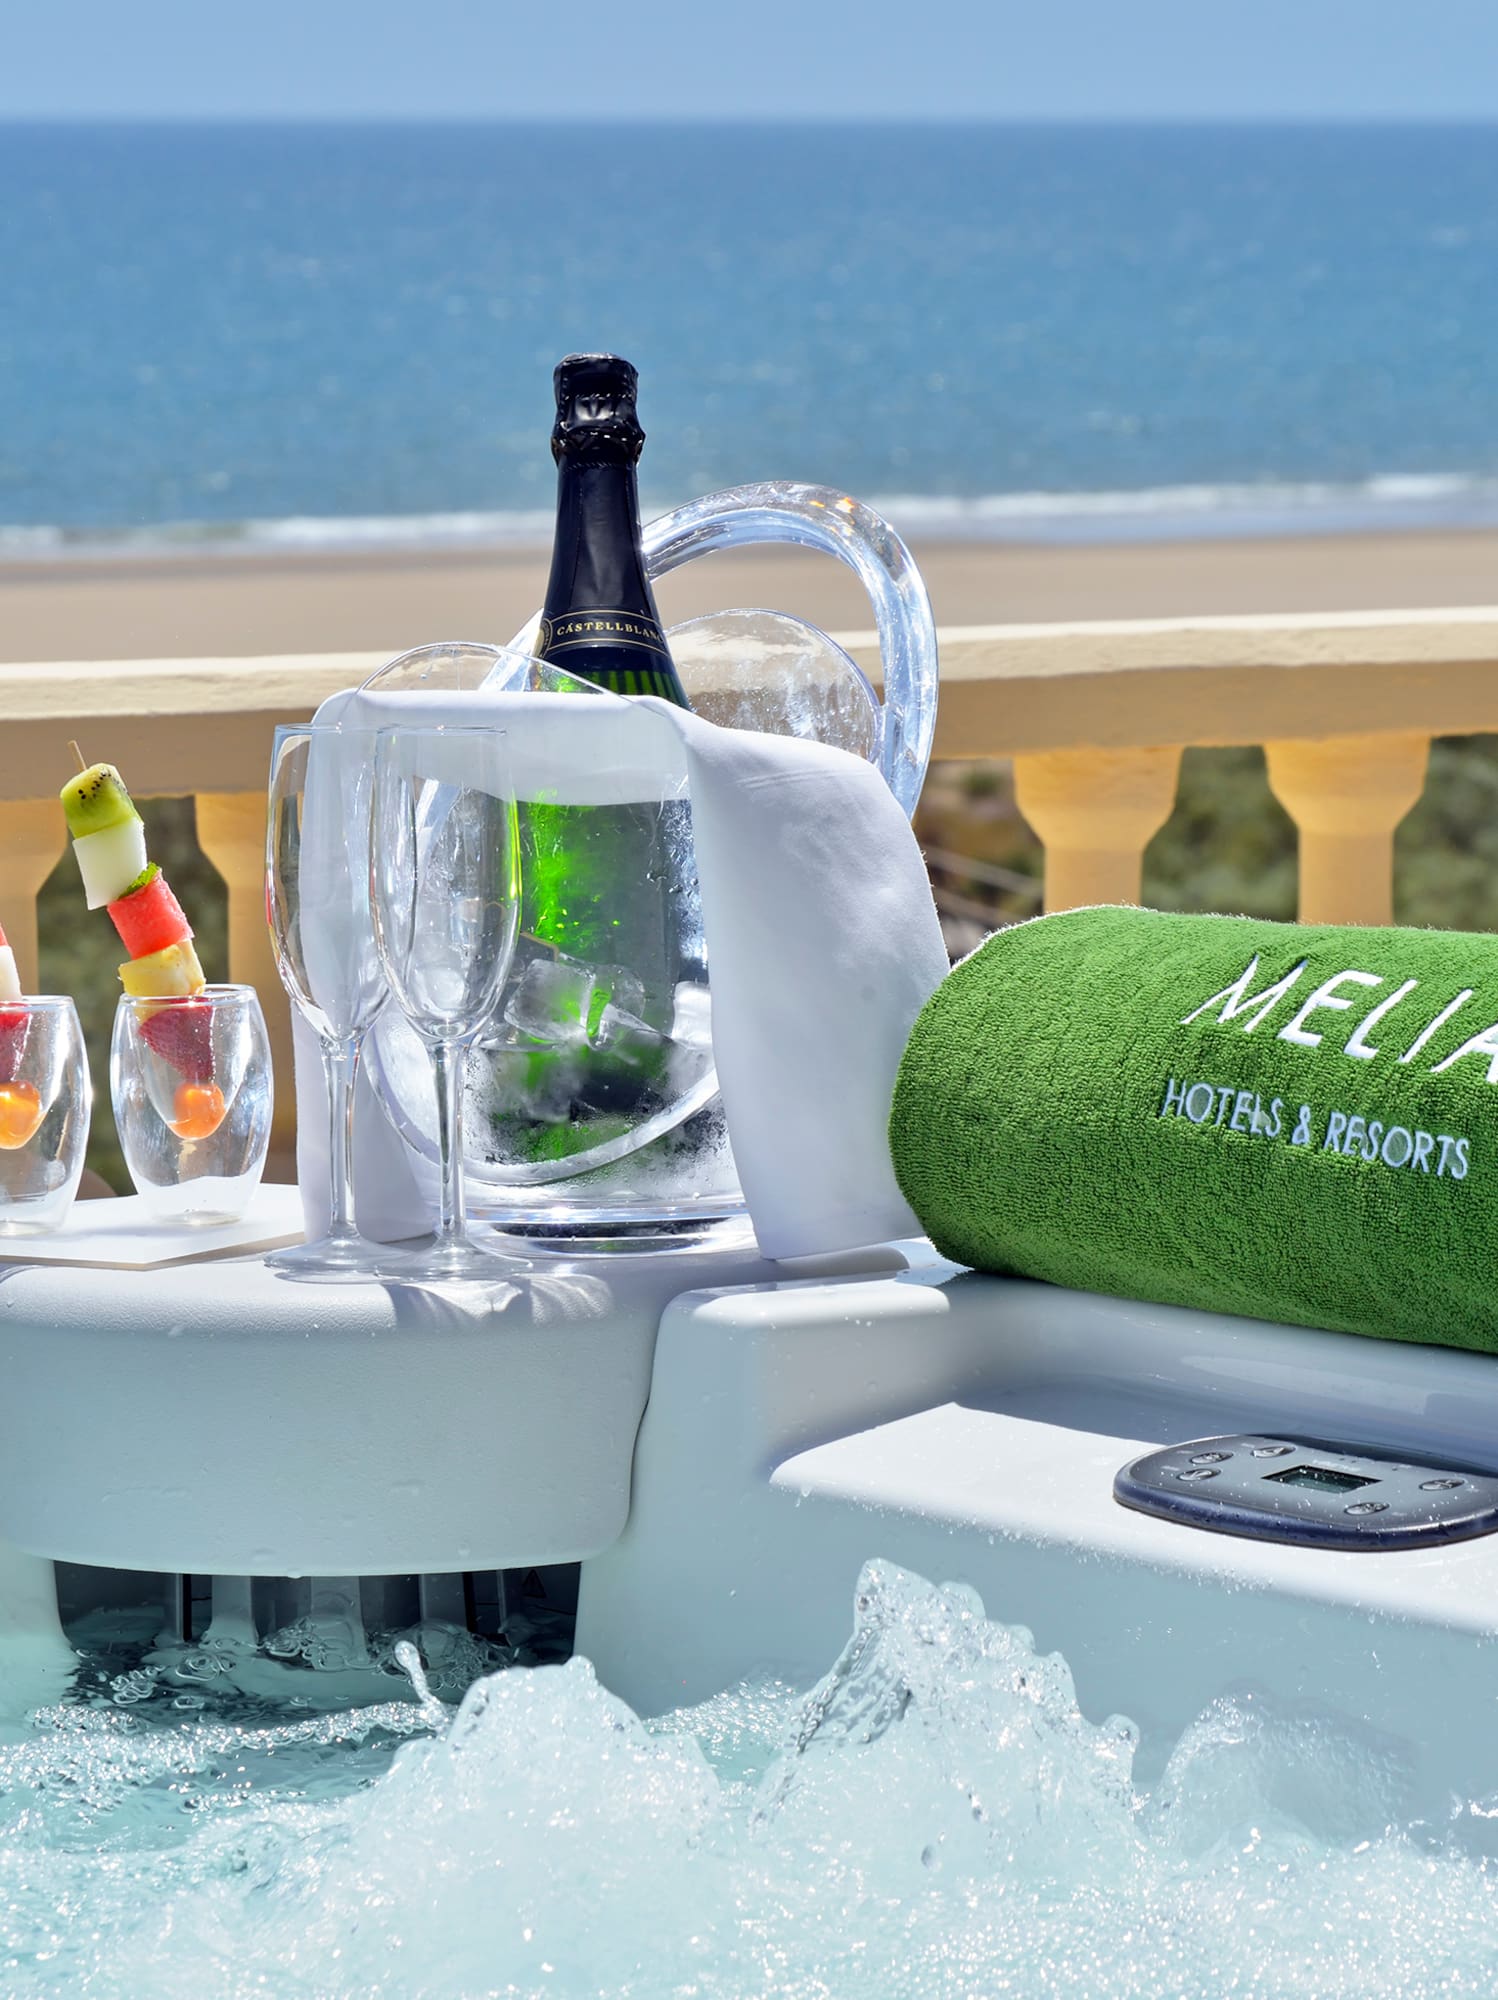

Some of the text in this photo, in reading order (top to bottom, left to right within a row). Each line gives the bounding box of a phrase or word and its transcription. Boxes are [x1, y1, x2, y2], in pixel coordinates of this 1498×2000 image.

[1161, 1079, 1471, 1180] HOTELS & RESORTS
